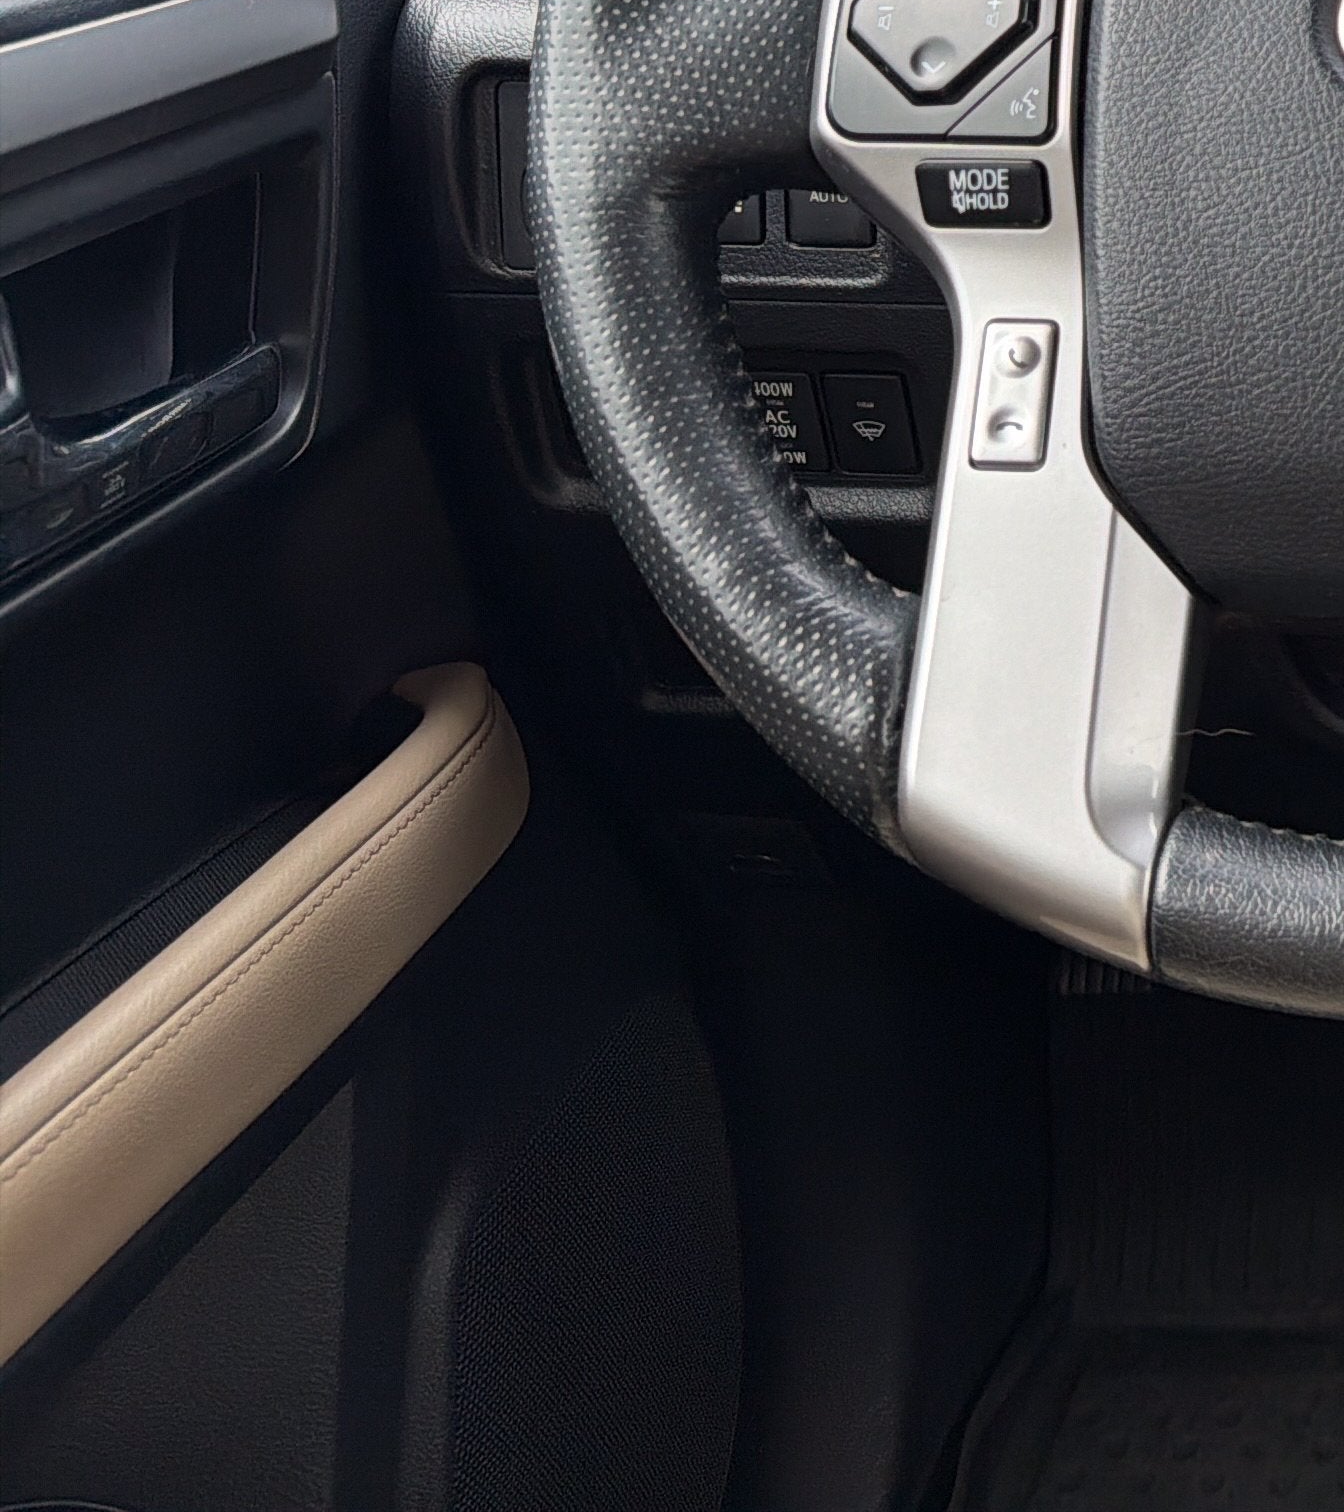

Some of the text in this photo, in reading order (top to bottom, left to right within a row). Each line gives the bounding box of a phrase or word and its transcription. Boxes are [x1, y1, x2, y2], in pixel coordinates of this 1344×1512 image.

[948, 168, 1010, 191] MODE
[965, 192, 1009, 210] HOLD
[765, 409, 791, 424] AC
[767, 424, 797, 438] 20V
